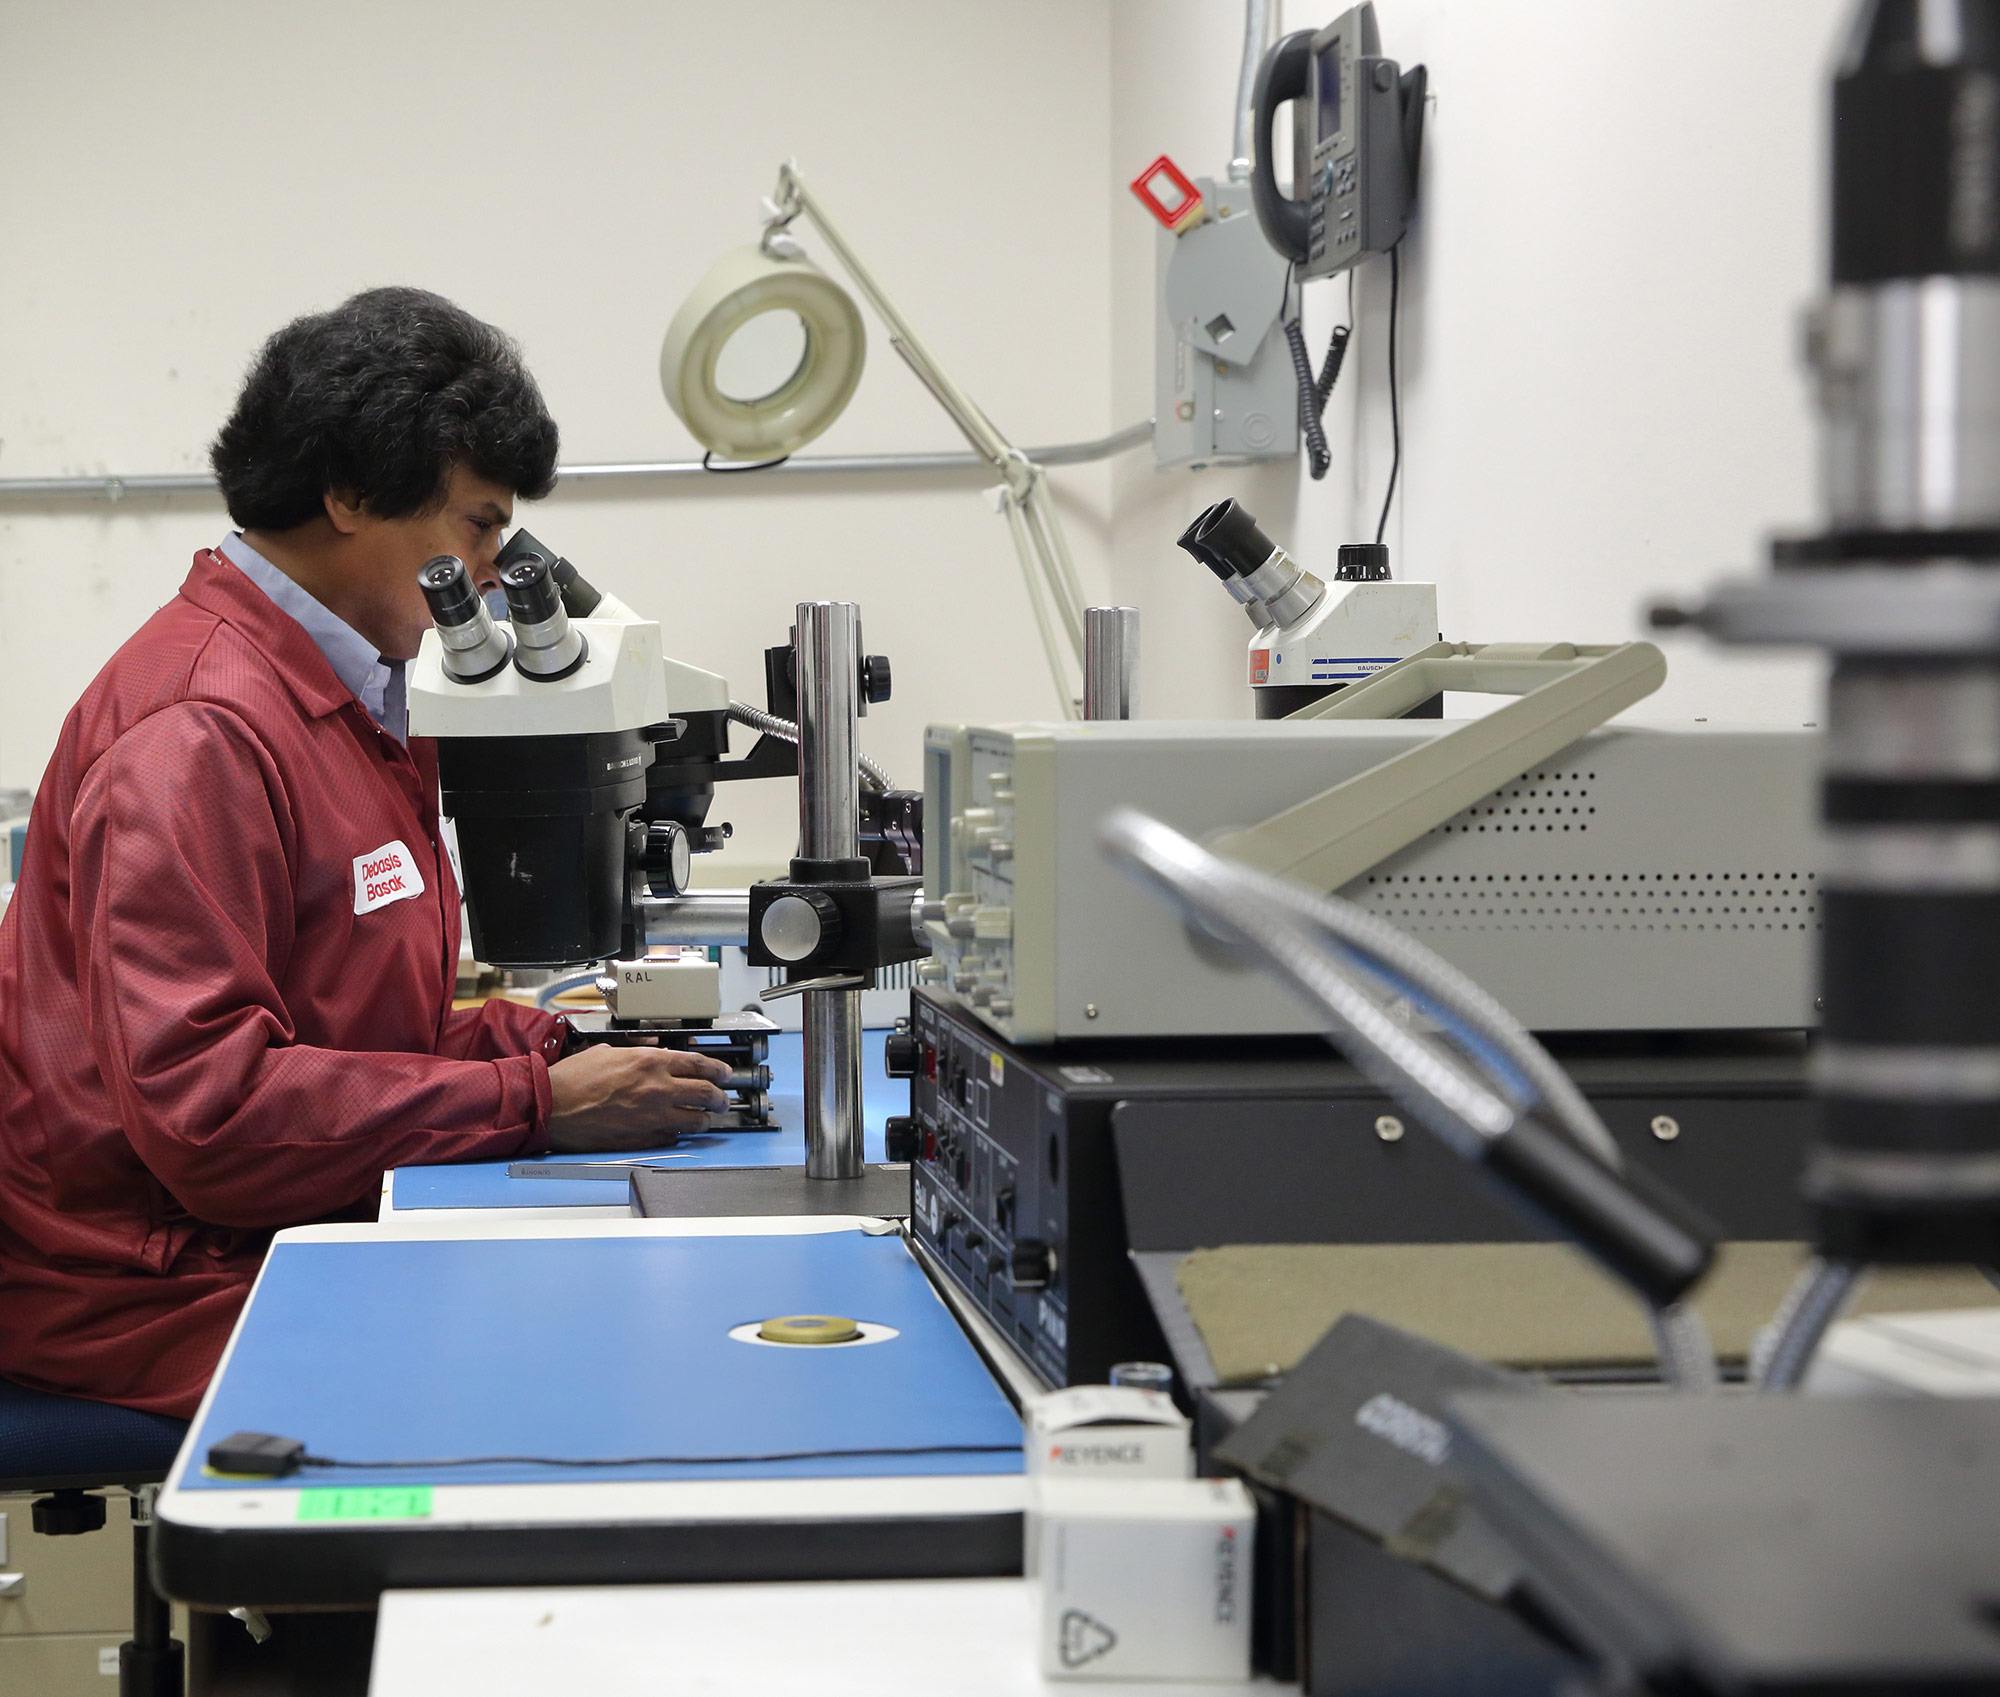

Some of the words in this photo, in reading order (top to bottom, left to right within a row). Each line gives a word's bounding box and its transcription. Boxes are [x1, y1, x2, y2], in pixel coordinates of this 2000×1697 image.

[362, 853, 402, 882] Debasis
[367, 875, 406, 901] Basak
[625, 971, 652, 983] RAL
[1050, 1443, 1145, 1466] KEYENCE
[1214, 1526, 1236, 1625] KEYENCE
